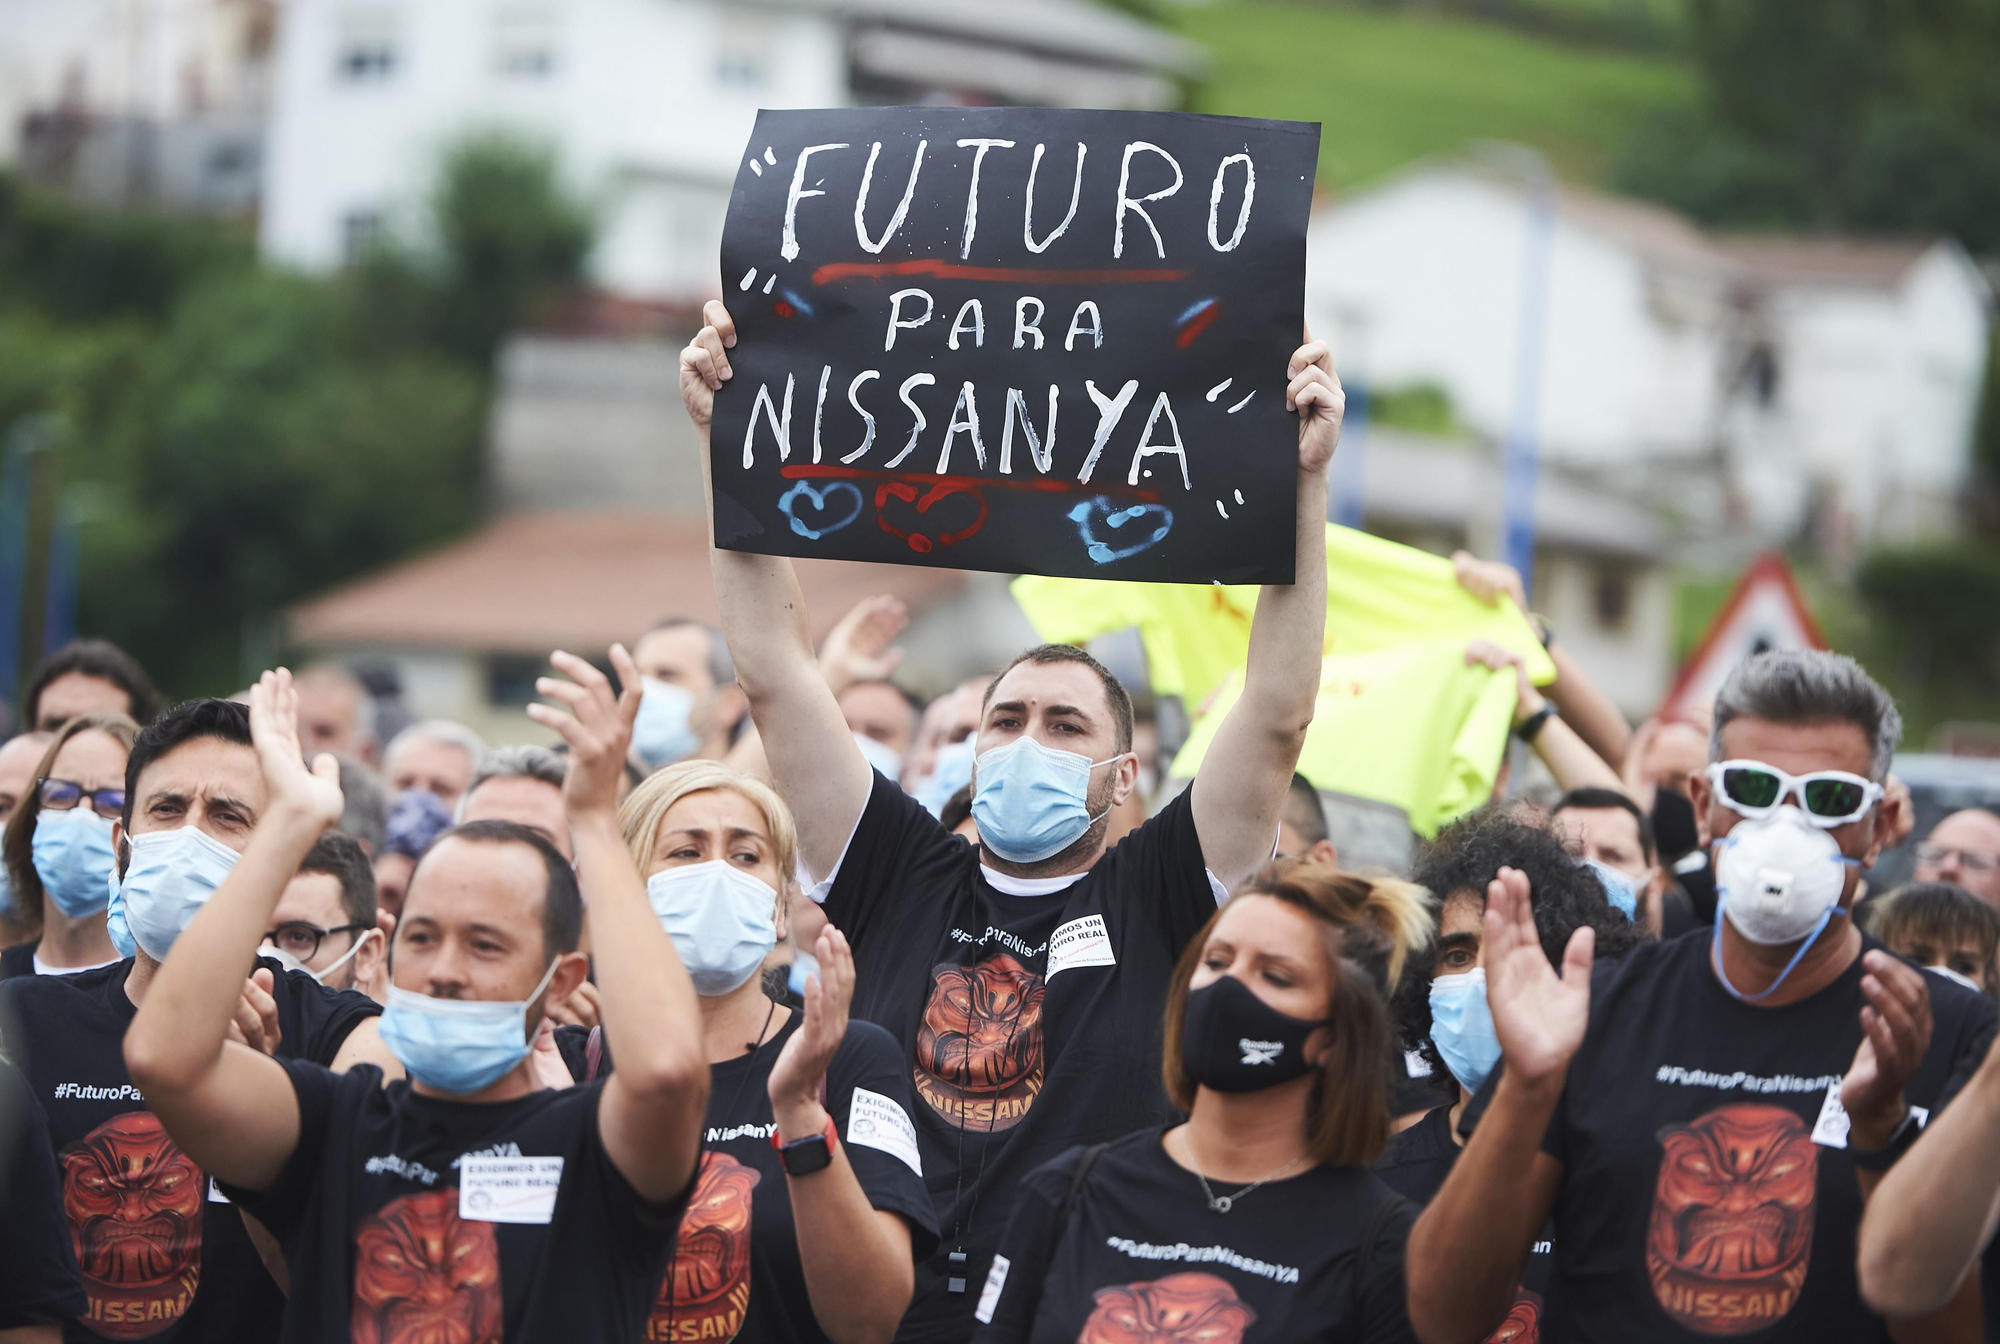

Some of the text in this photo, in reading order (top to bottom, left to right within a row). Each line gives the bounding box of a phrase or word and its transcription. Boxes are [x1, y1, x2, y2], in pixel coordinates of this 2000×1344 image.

[885, 288, 1104, 351] PARA
[1078, 930, 1106, 940] REAL
[1085, 918, 1102, 928] UN
[54, 1083, 145, 1101] #FuturoPa
[922, 1088, 1035, 1121] NISSAN
[1107, 1236, 1299, 1284] #FuturoParaNissanYA
[1659, 1280, 1791, 1318] NISSAN
[647, 1309, 738, 1341] ISSAN
